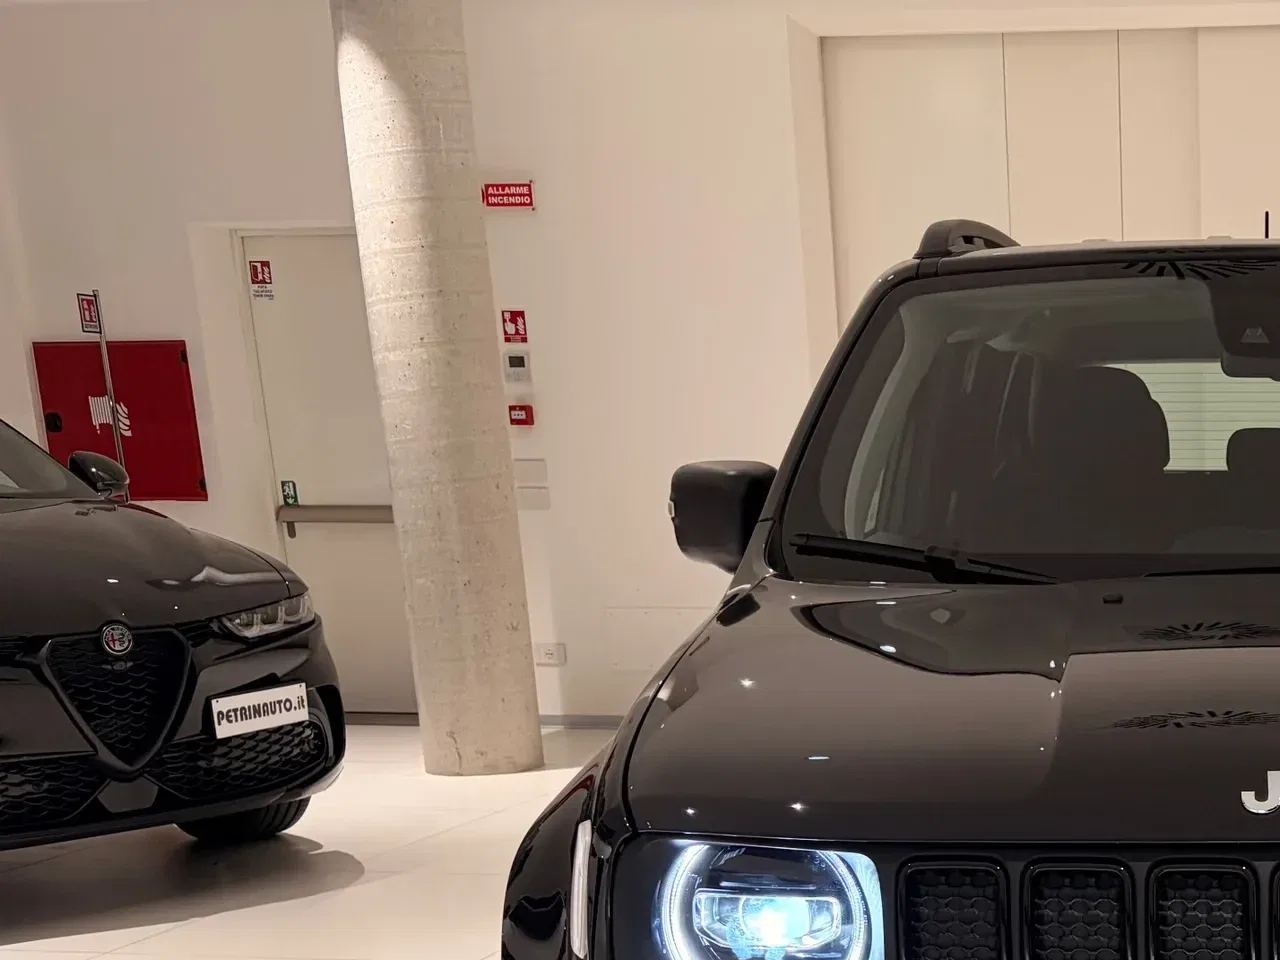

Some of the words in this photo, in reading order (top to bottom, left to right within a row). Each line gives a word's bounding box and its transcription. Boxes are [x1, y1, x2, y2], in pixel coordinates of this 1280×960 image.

[488, 186, 530, 195] ALLARME
[488, 196, 531, 204] INCENDIO
[216, 695, 306, 727] PETRINAUTO.it
